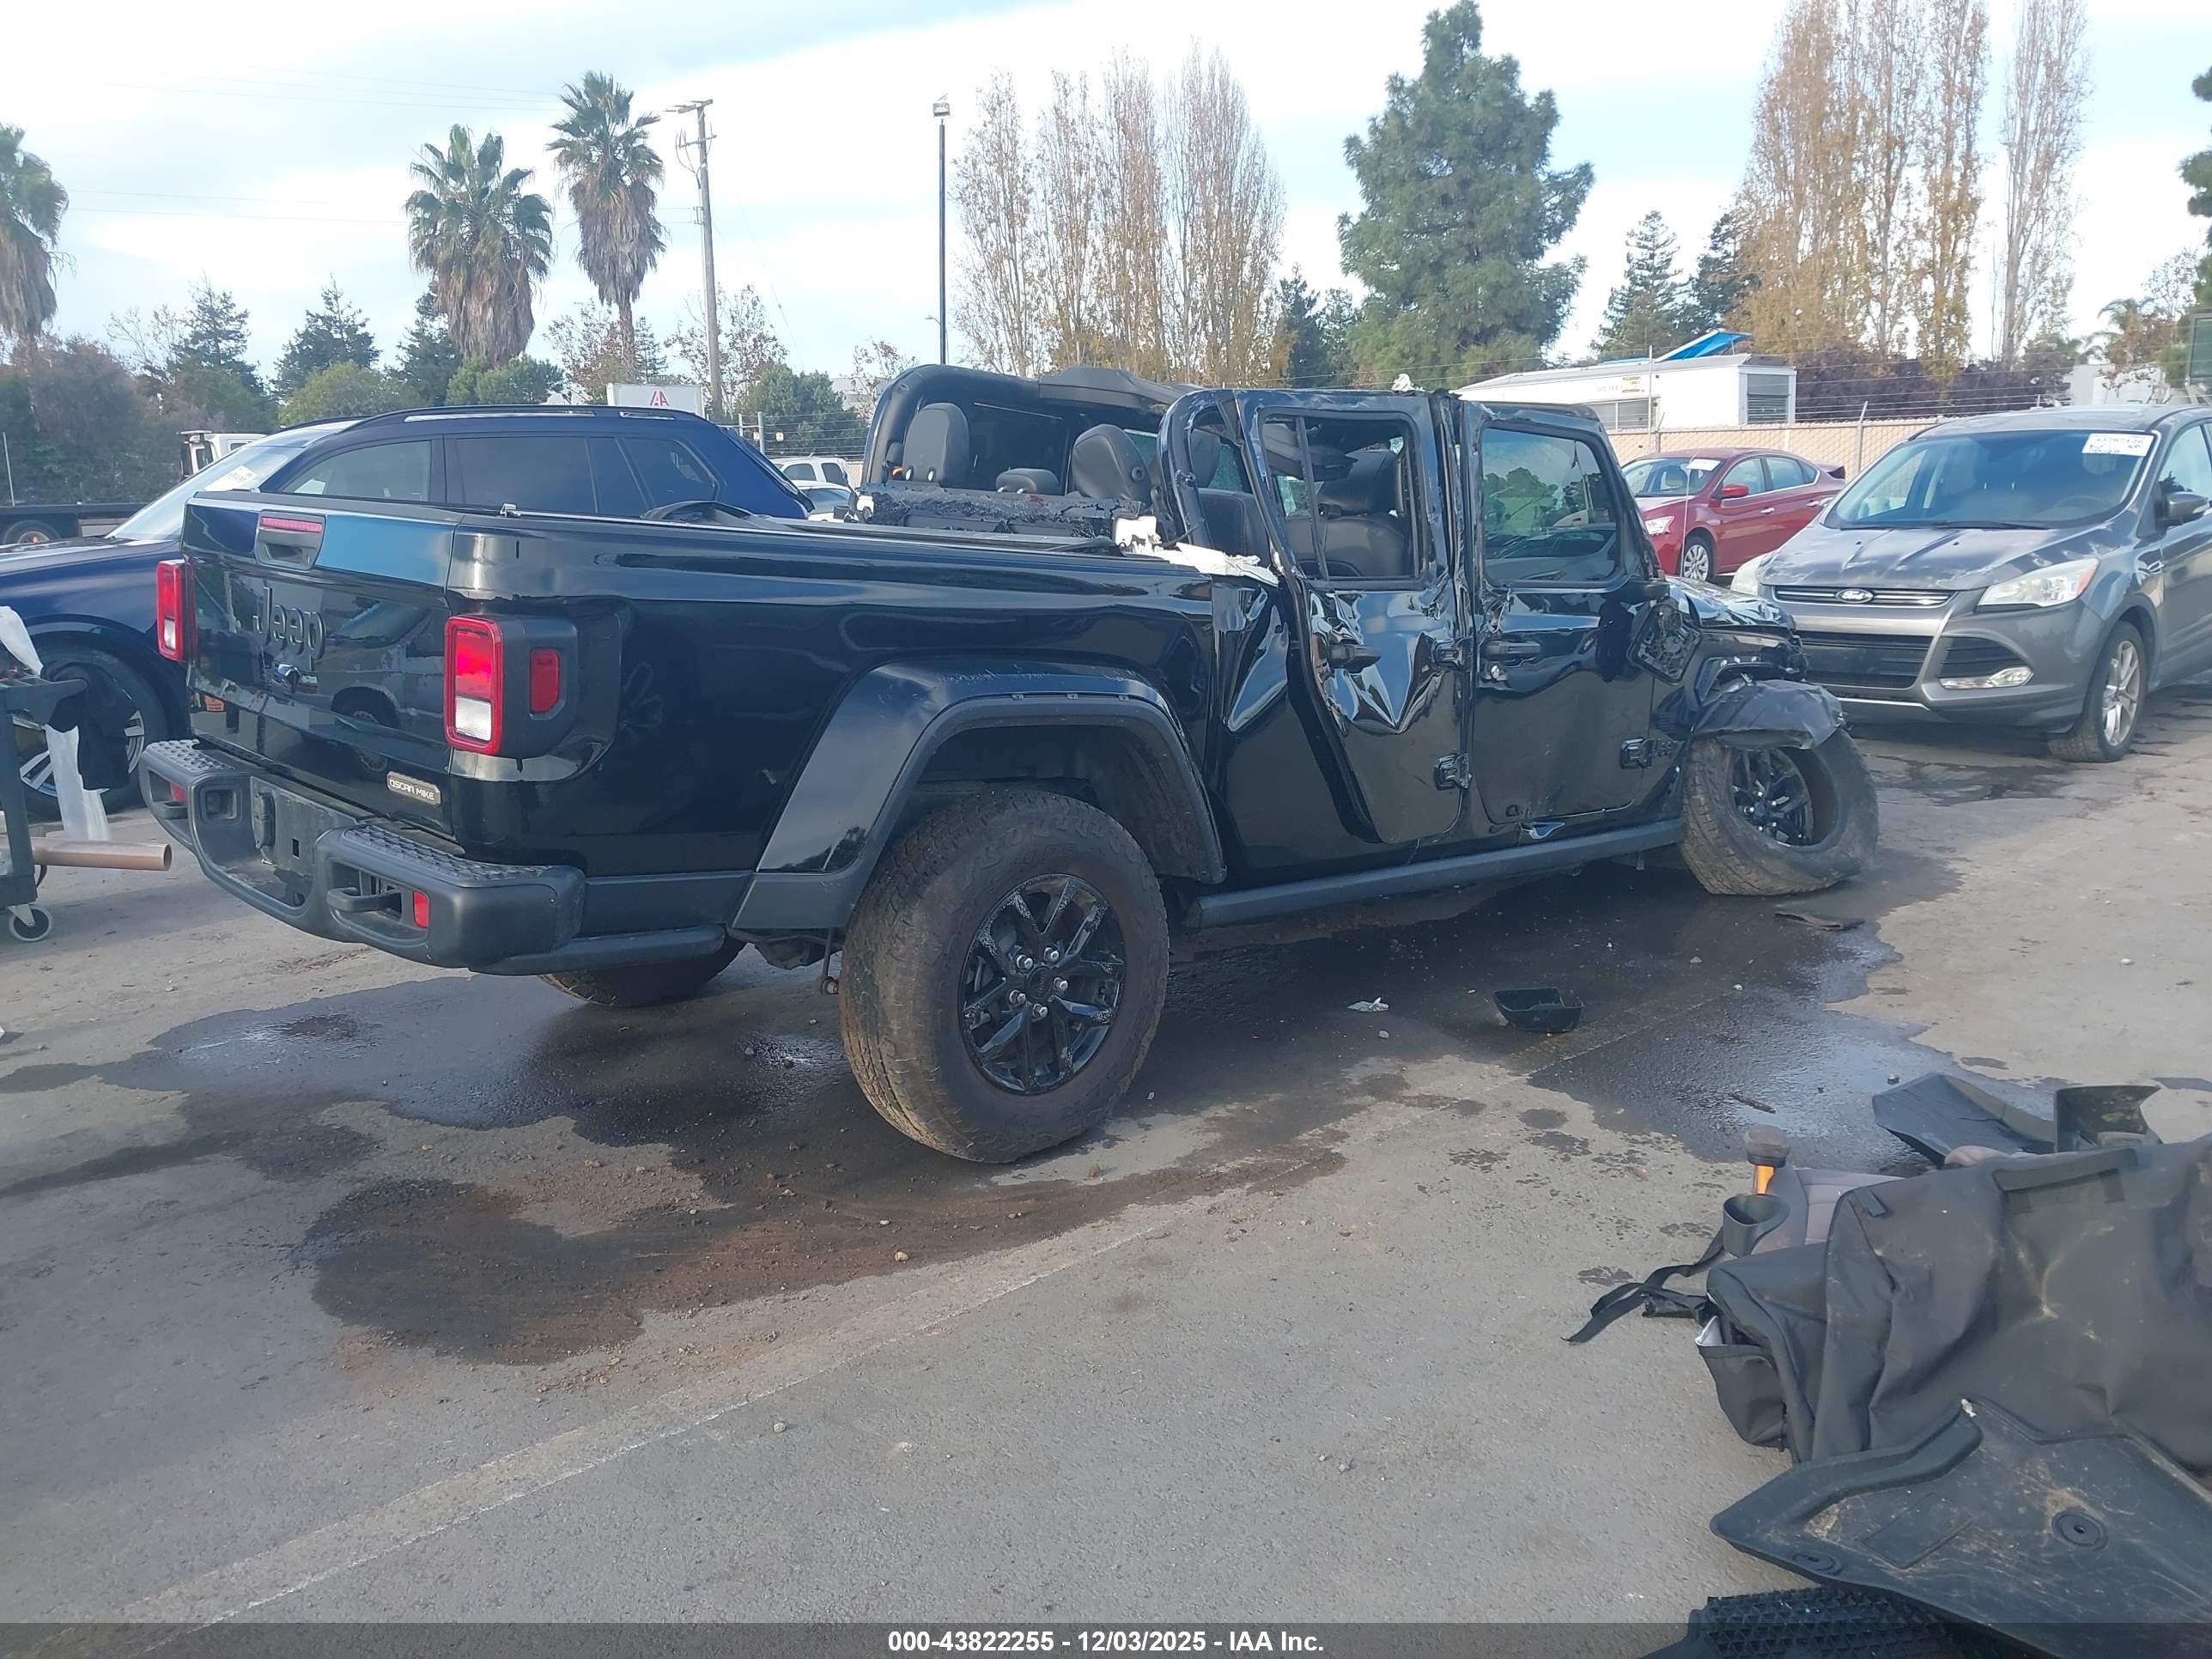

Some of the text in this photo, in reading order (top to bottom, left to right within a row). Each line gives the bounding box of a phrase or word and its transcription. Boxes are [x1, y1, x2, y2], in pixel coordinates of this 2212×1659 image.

[252, 586, 326, 672] Jeep
[389, 778, 434, 800] OSCAR MIKE
